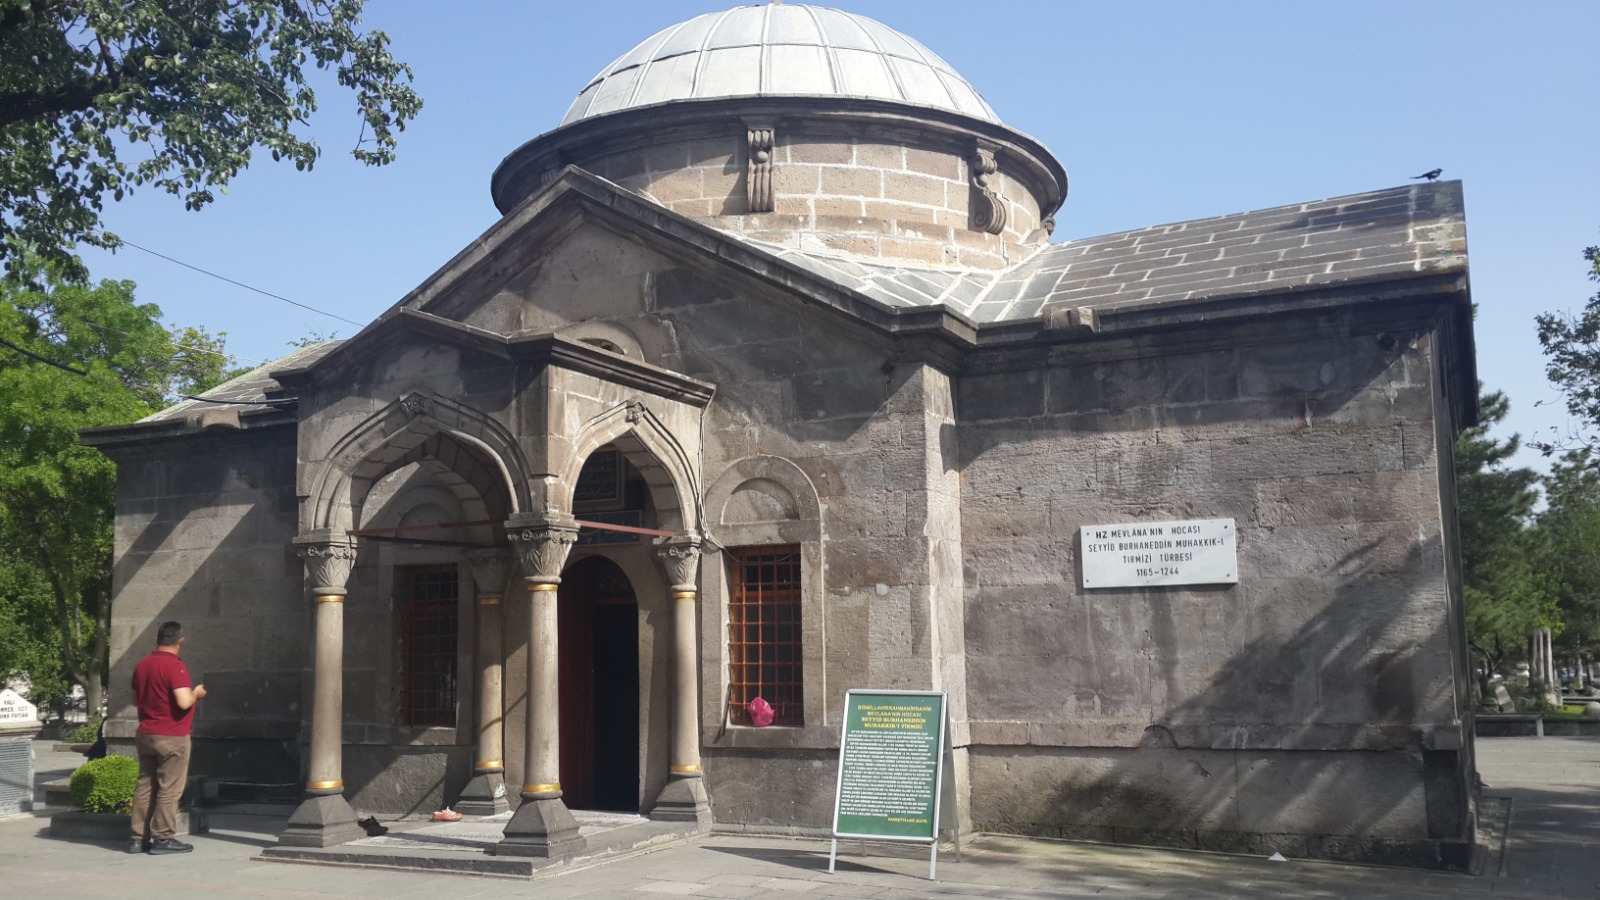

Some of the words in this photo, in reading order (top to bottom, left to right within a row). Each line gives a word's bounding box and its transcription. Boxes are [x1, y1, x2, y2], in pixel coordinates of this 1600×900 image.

[1096, 530, 1108, 539] HZ
[1171, 526, 1200, 534] HOCASI
[1088, 542, 1115, 552] SEYYİD
[1118, 540, 1172, 551] BURHANEDDİN
[1175, 538, 1224, 549] MUHAKKIK-I
[1160, 552, 1193, 562] TÜRBESİ
